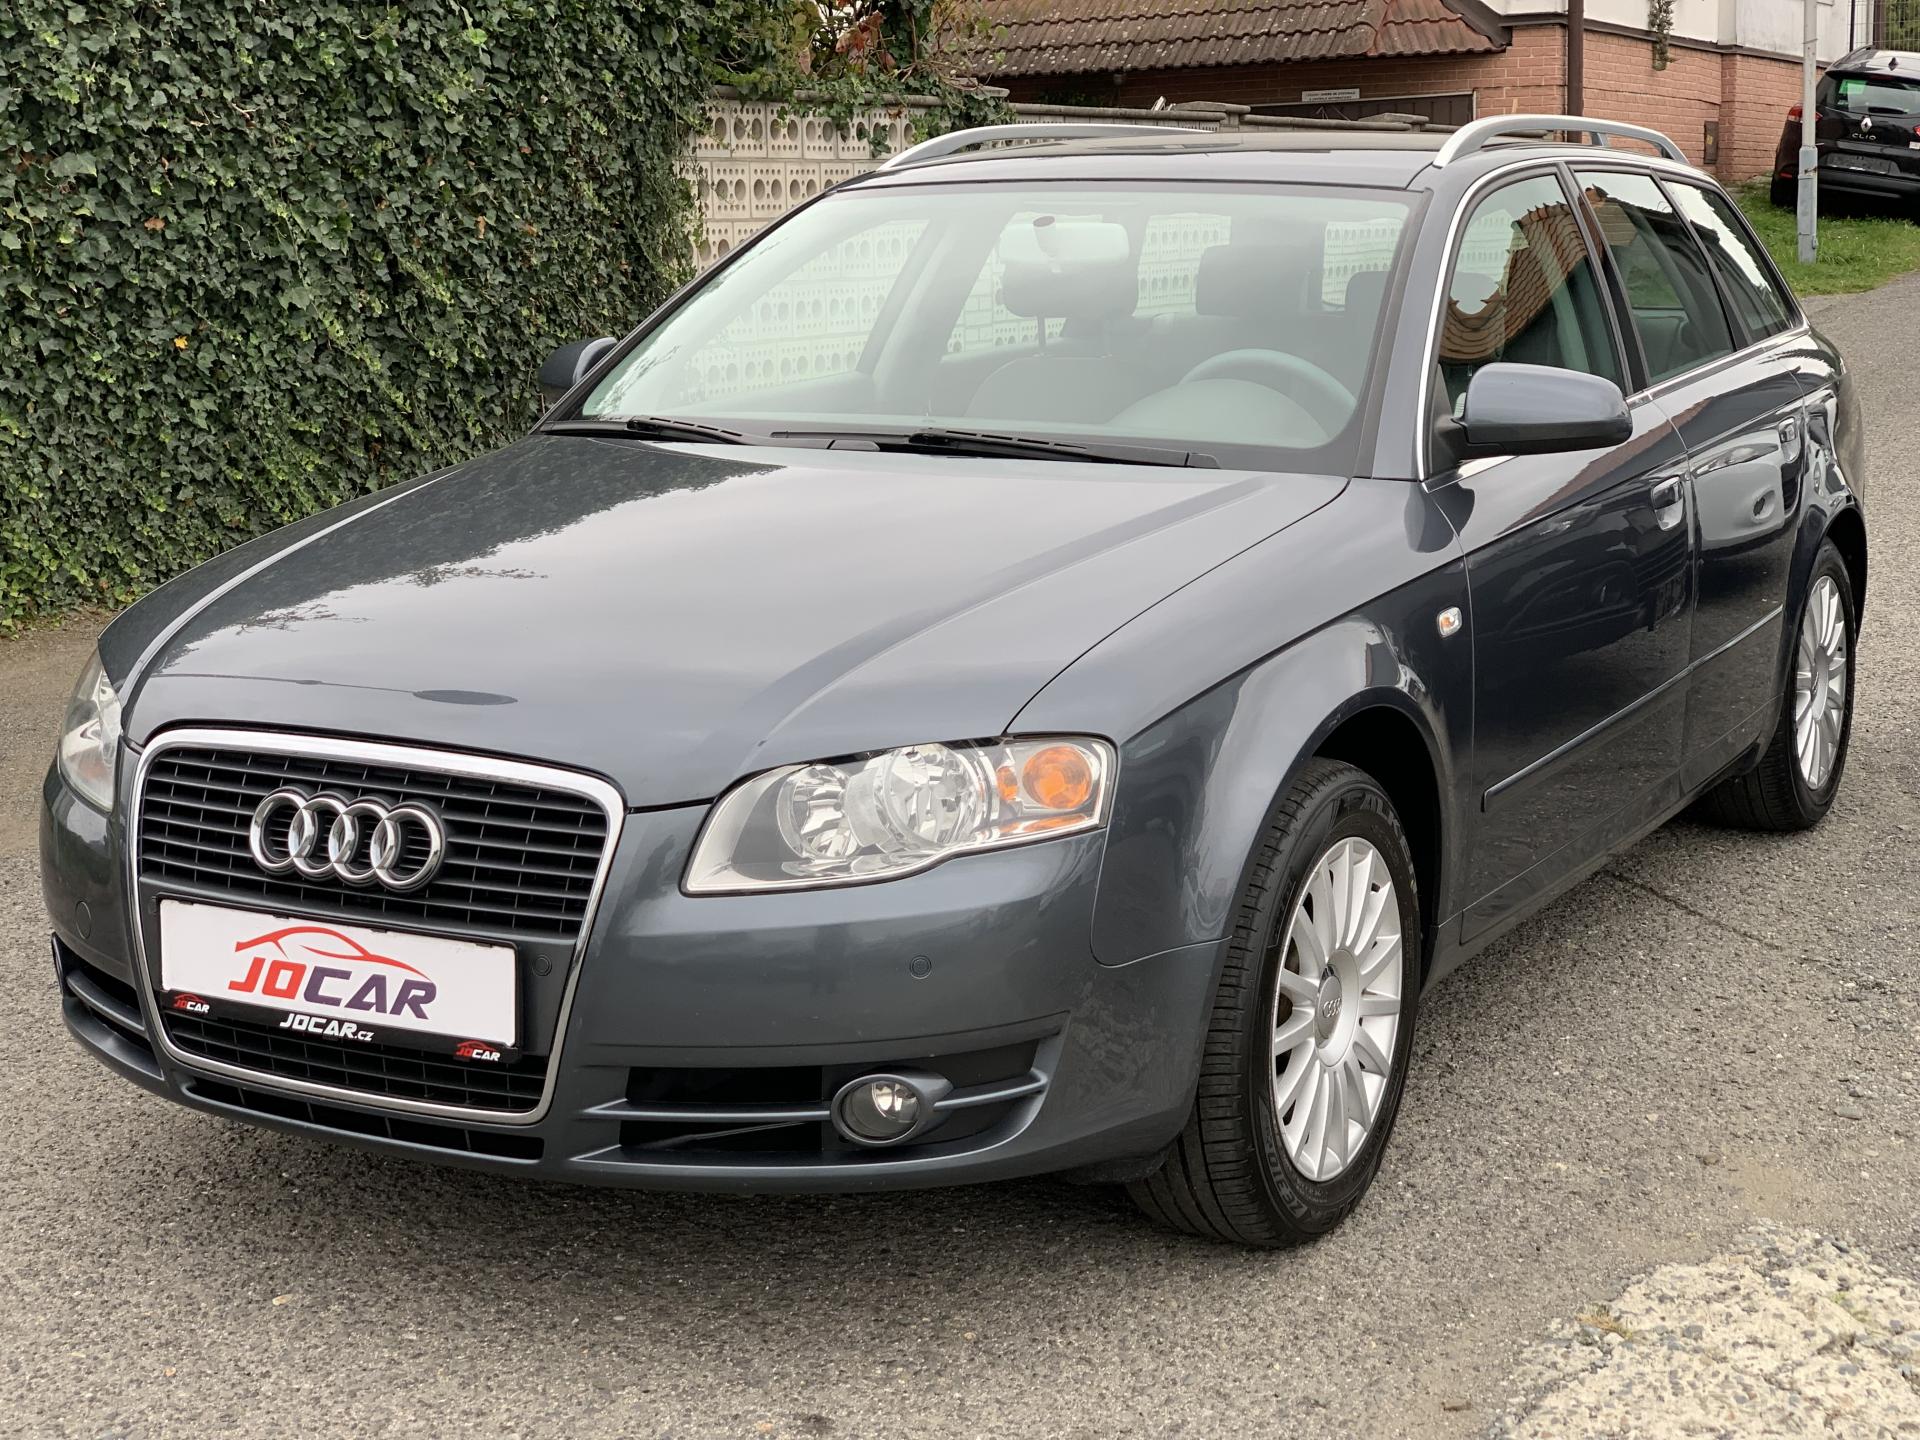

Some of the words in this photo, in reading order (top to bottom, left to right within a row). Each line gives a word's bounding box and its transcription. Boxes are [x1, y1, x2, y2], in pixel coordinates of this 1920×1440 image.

[1852, 132, 1877, 140] CLIO
[228, 957, 436, 1020] JOCAR
[174, 999, 210, 1014] JOCAR
[456, 1046, 500, 1061] JOCAR
